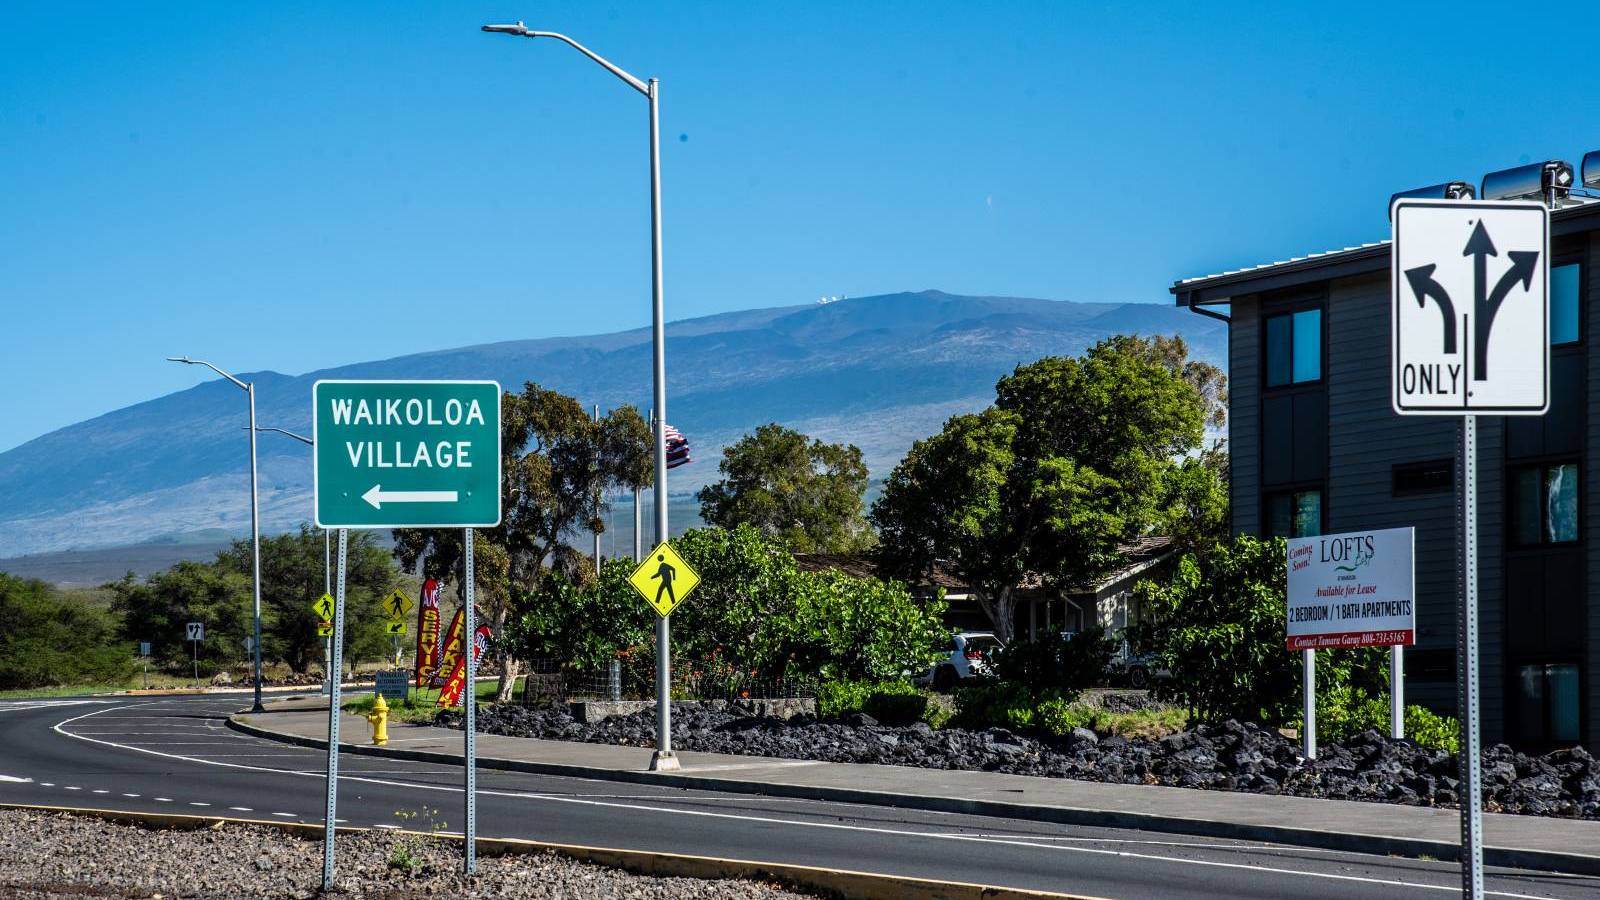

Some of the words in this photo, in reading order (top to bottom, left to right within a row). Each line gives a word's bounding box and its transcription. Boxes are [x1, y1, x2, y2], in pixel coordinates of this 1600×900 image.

[1403, 363, 1461, 395] ONLY
[331, 398, 485, 425] WAIKOLOA
[346, 441, 472, 468] VILLAGE
[1289, 544, 1312, 559] Coming
[1320, 535, 1374, 562] LOFTS
[1292, 556, 1310, 571] Soon!
[1316, 586, 1344, 598] Available
[1344, 584, 1356, 598] for
[1357, 583, 1377, 595] Lease
[1289, 607, 1295, 623] 2
[1295, 605, 1329, 622] BEDROOM
[1330, 604, 1334, 620] /
[1336, 604, 1341, 620] 1
[1342, 603, 1361, 620] BATH
[1361, 600, 1411, 618] APARTMENTS
